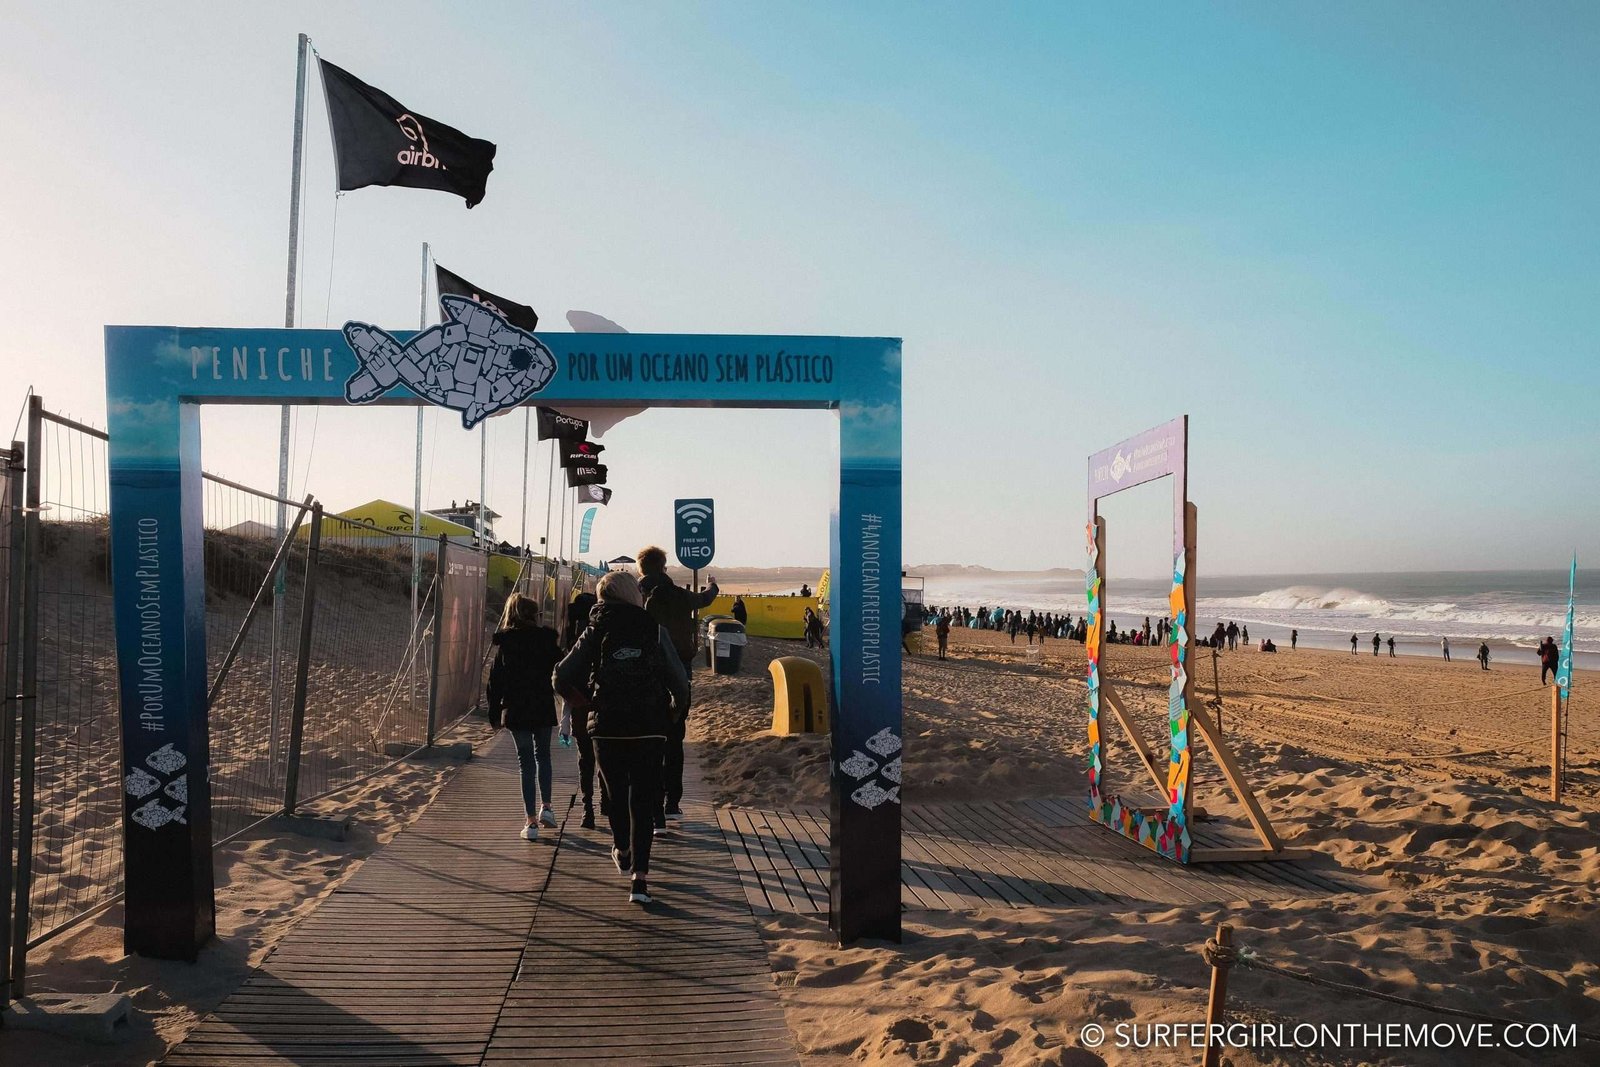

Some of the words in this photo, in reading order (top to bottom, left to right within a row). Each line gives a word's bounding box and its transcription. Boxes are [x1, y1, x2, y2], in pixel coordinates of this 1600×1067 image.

[191, 346, 334, 380] PENICHE
[568, 352, 599, 382] POR
[606, 353, 633, 382] UM
[640, 353, 708, 382] OCEANO
[716, 354, 748, 382] SEM
[756, 350, 833, 384] PLÁSTICO
[680, 546, 711, 557] MEO
